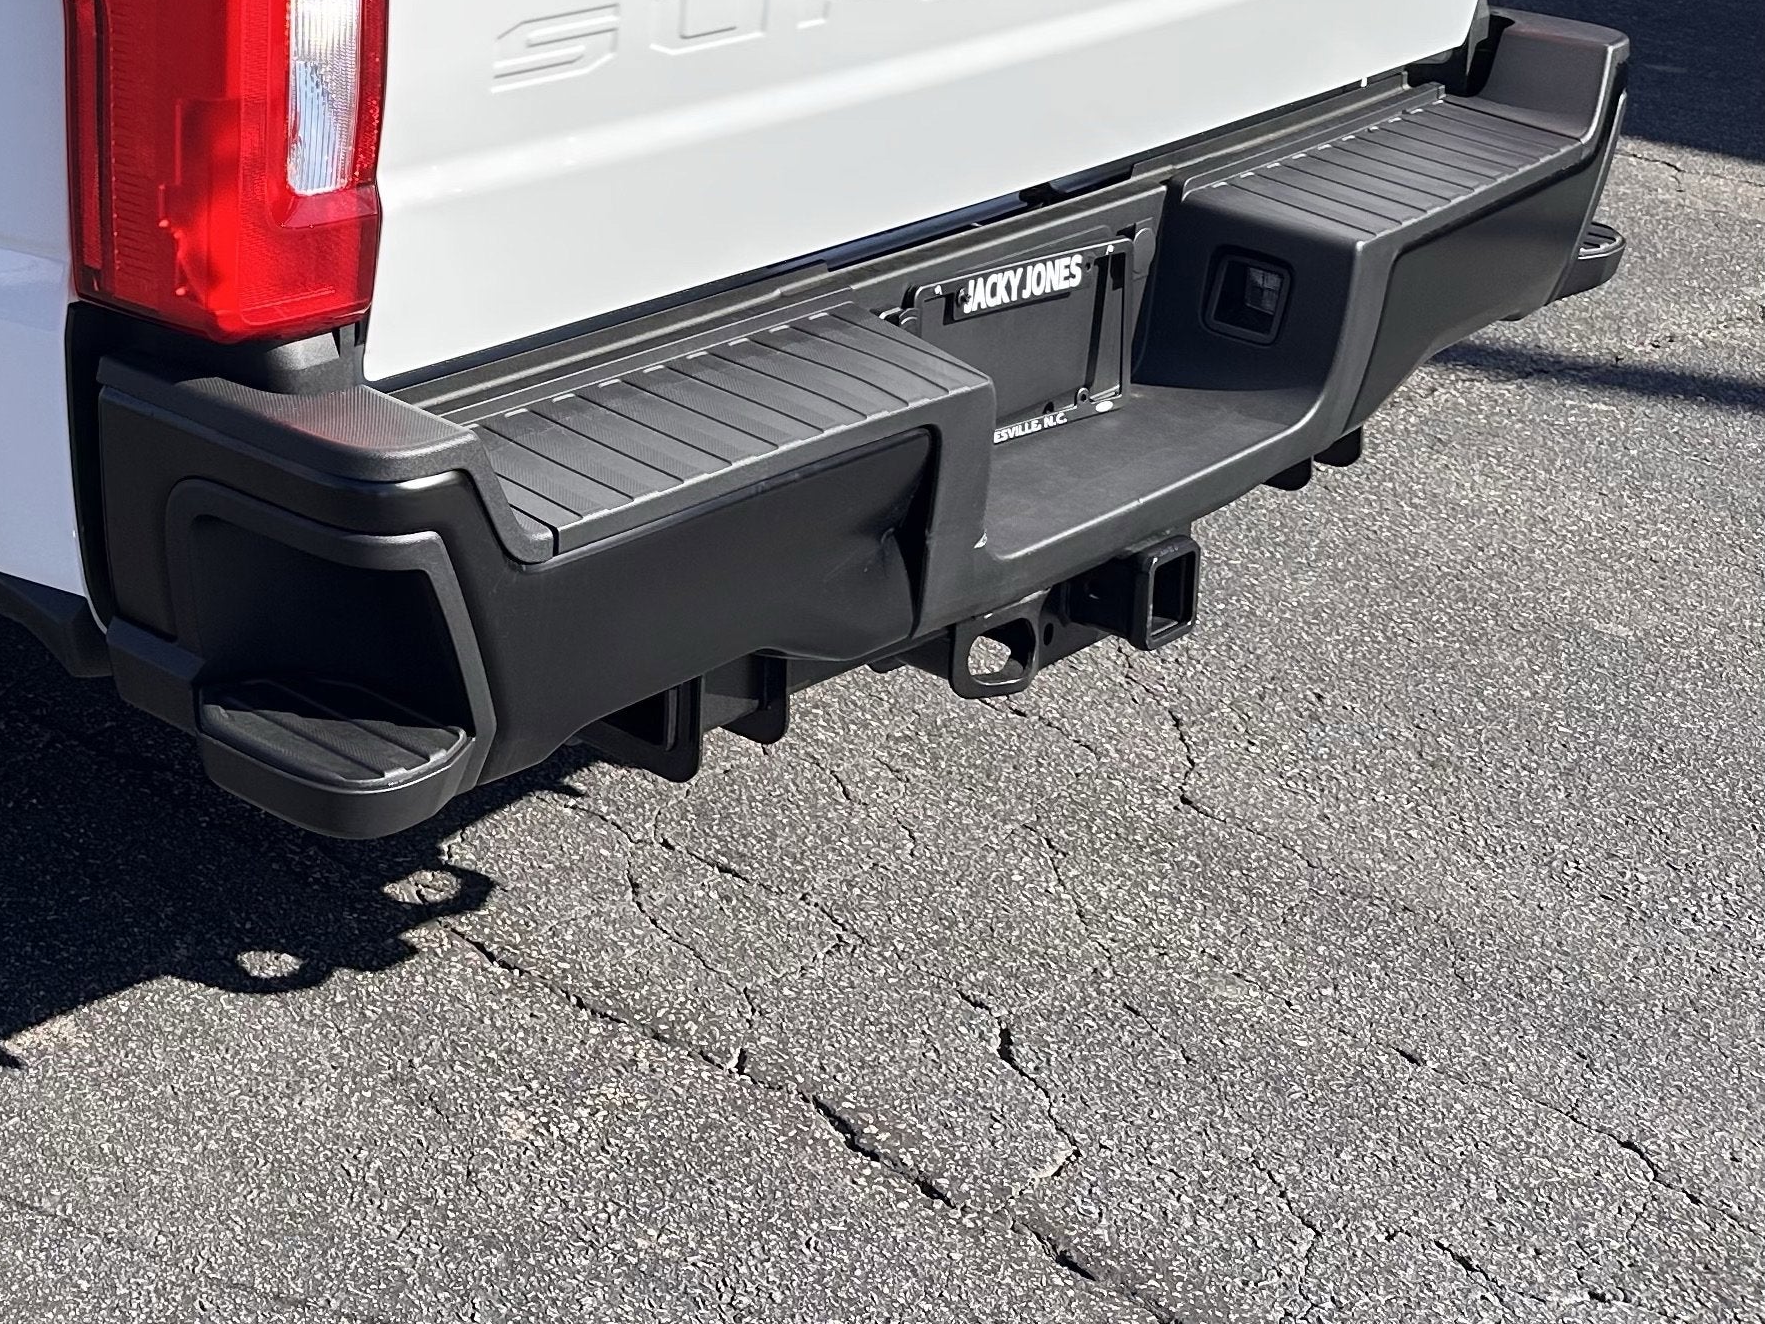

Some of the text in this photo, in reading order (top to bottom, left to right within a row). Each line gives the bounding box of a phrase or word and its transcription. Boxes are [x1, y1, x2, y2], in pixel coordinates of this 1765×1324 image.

[963, 253, 1084, 314] JACKY JONES
[1043, 410, 1069, 429] N.C.
